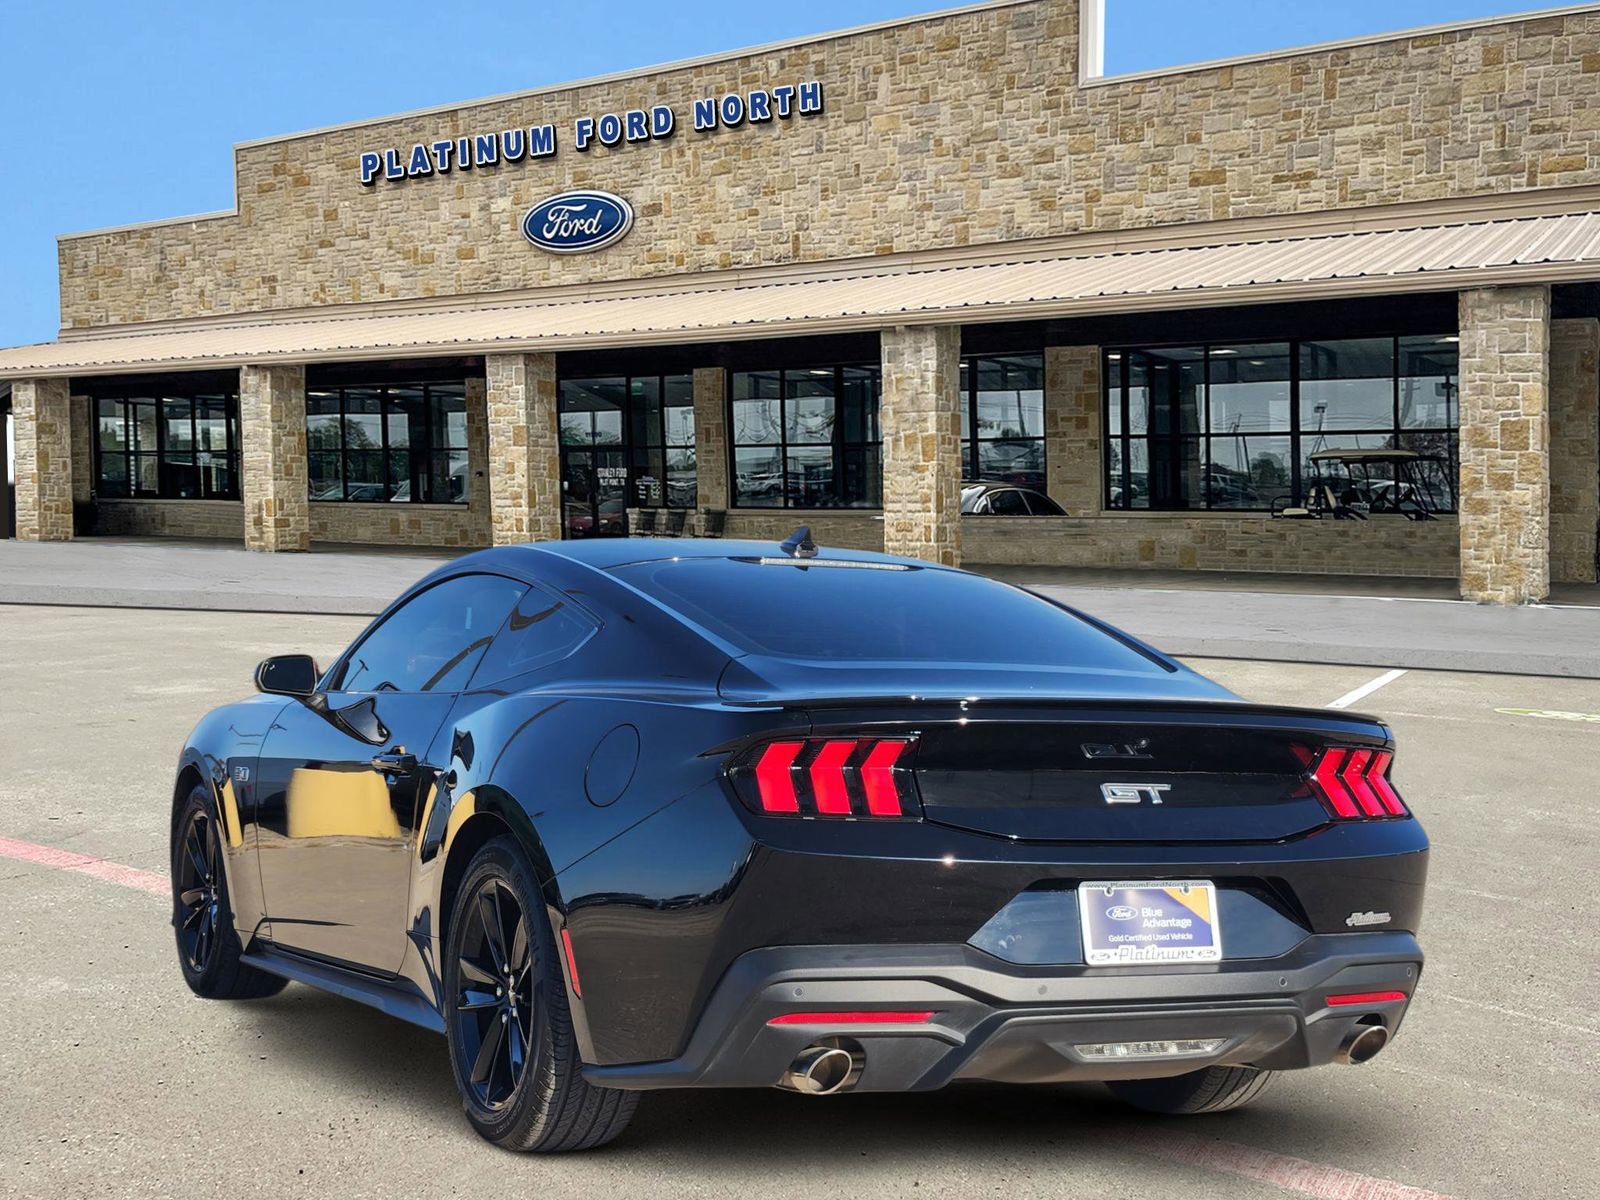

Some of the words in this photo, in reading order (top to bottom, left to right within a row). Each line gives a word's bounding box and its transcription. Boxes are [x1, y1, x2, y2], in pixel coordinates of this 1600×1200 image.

[360, 124, 556, 184] PLATINUM
[576, 105, 673, 151] FORD
[694, 81, 822, 132] NORTH
[543, 203, 602, 239] Ford
[1100, 783, 1171, 804] GT
[1141, 907, 1162, 917] Blue
[1142, 917, 1192, 929] Advantage
[1108, 934, 1124, 943] Gold
[1125, 933, 1152, 942] Certified
[1154, 933, 1169, 941] Used
[1170, 932, 1193, 941] Vehicle
[1118, 945, 1194, 961] Platinum
